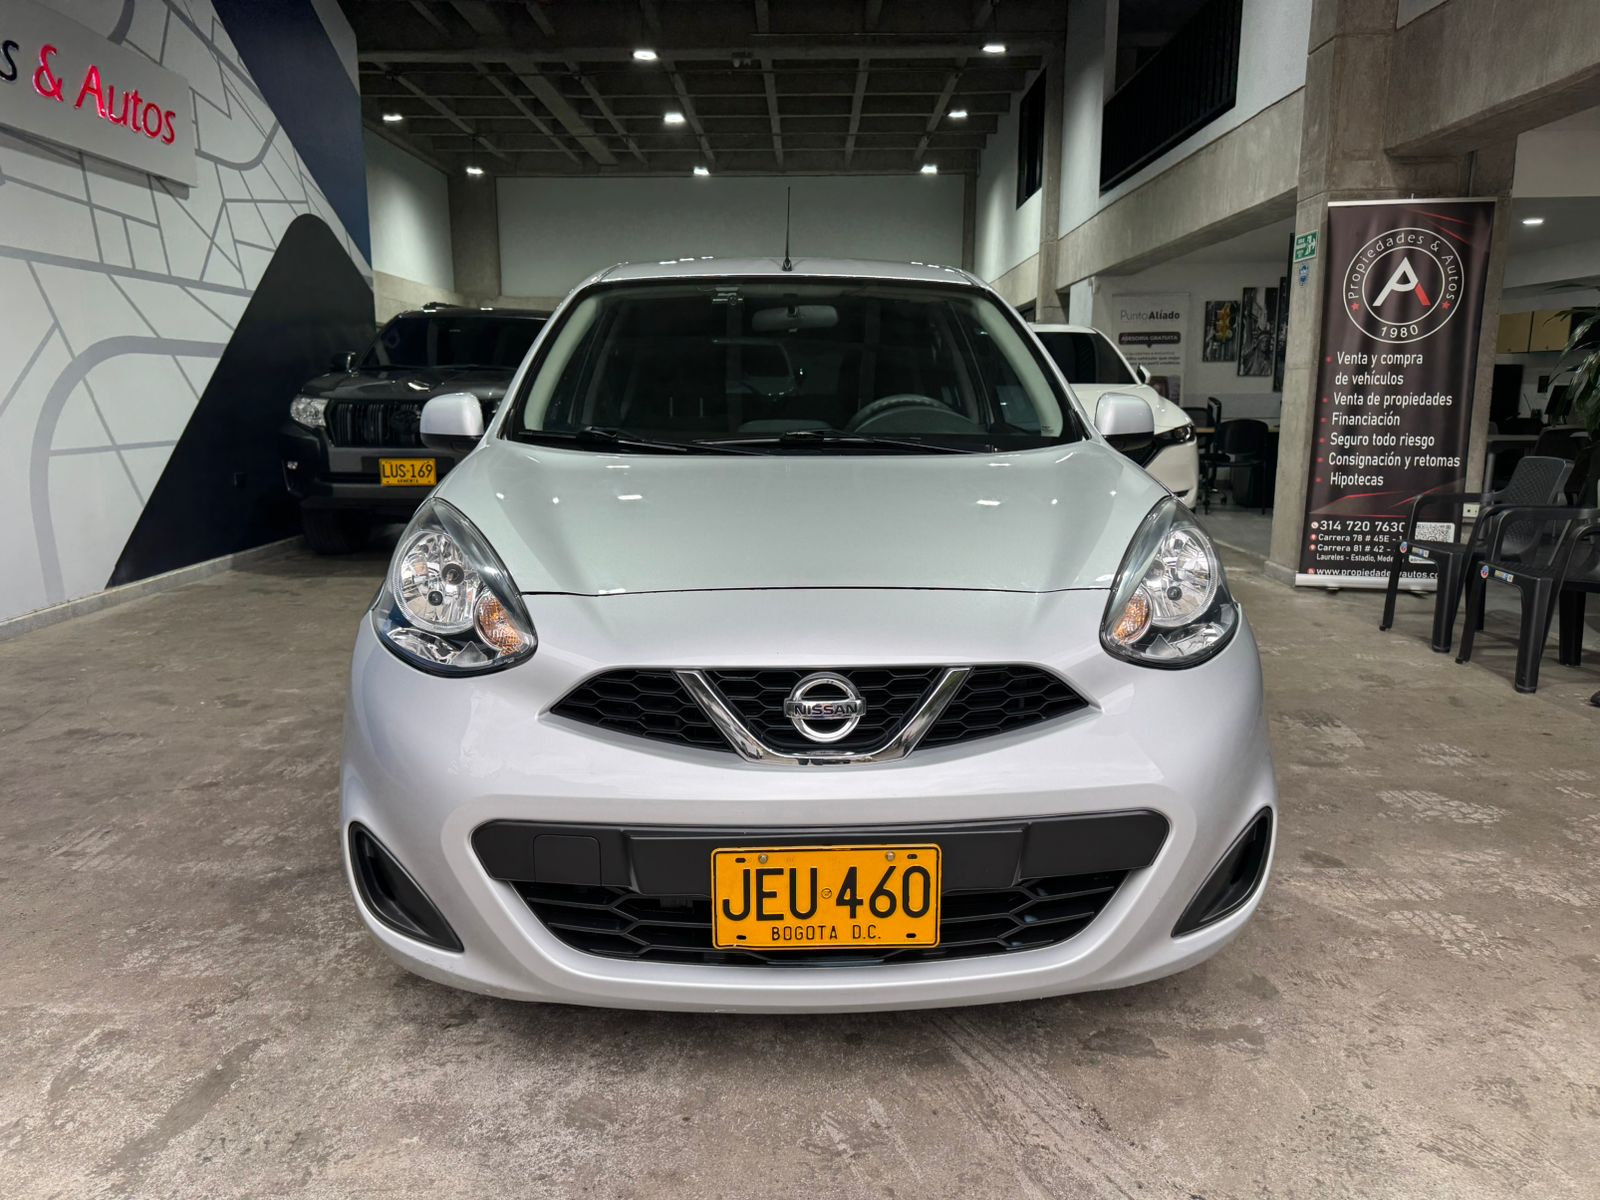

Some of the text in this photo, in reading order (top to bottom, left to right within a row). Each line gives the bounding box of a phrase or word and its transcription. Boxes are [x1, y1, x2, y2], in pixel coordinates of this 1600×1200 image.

[32, 44, 64, 102] &
[74, 64, 176, 145] Autos
[1348, 231, 1458, 300] Propiedades & Autos
[1380, 325, 1419, 338] 1980
[1337, 351, 1423, 368] Venta y compra
[1335, 370, 1404, 385] de vehículos
[1333, 392, 1453, 408] Venta de propiedades
[1331, 410, 1400, 426] Financiación
[1330, 432, 1435, 449] Seguro todo riesgo
[1328, 451, 1461, 470] Consignación y retomas
[382, 464, 433, 478] LUS 169
[1330, 472, 1384, 488] Hipotecas
[1320, 520, 1341, 531] 314
[1346, 520, 1370, 532] 720
[1318, 534, 1350, 542] Carrera
[1353, 534, 1363, 542] 78
[1365, 534, 1371, 542] #
[1373, 535, 1389, 543] 45E
[1317, 544, 1350, 552] Carrera
[1353, 544, 1362, 552] 81
[1364, 544, 1371, 552] #
[1373, 545, 1385, 553] 42
[1316, 553, 1344, 561] Laureles
[1350, 554, 1376, 563] Estadio,
[794, 703, 858, 715] NISSAN
[722, 865, 931, 921] JEU 460
[771, 924, 881, 941] BOGOTA D.C.
